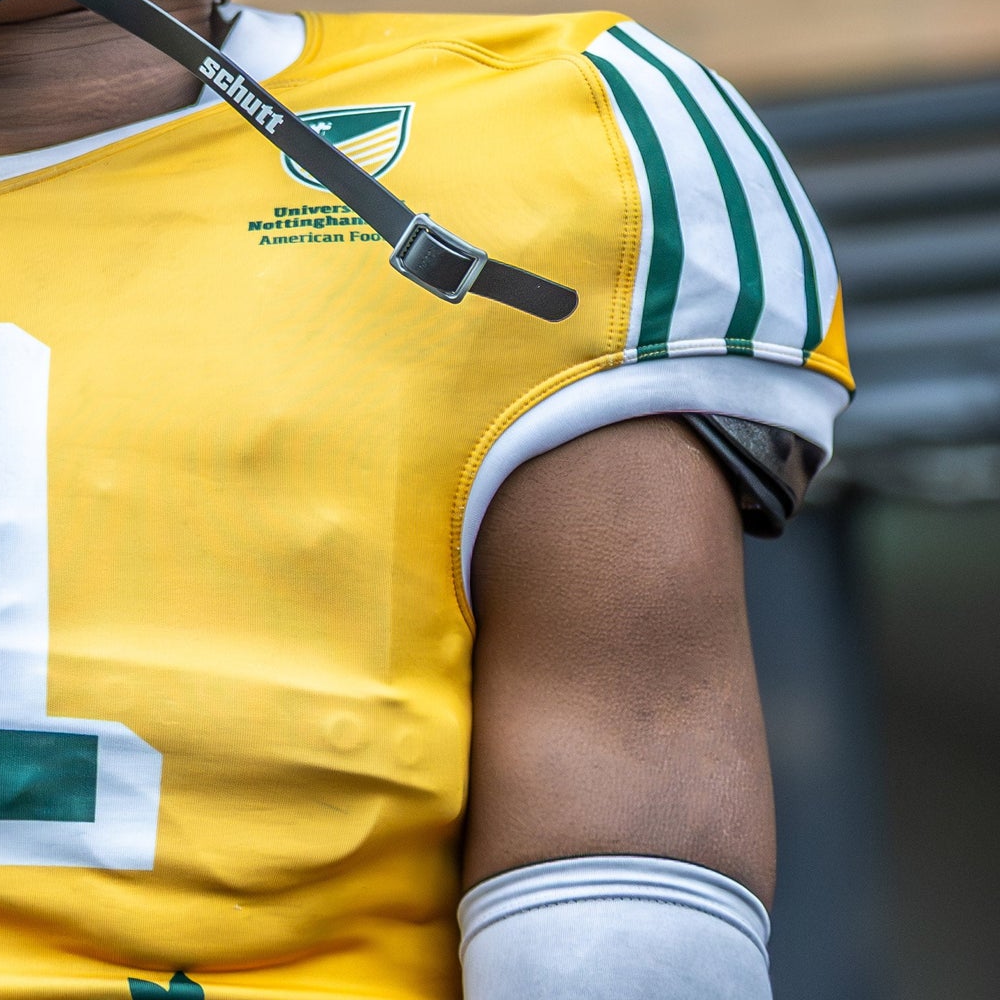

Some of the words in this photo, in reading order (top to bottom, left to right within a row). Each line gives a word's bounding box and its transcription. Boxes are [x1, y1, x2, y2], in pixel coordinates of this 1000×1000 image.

[199, 56, 284, 134] schutt
[273, 204, 351, 218] Univers
[259, 231, 344, 245] American
[350, 231, 384, 242] Foo
